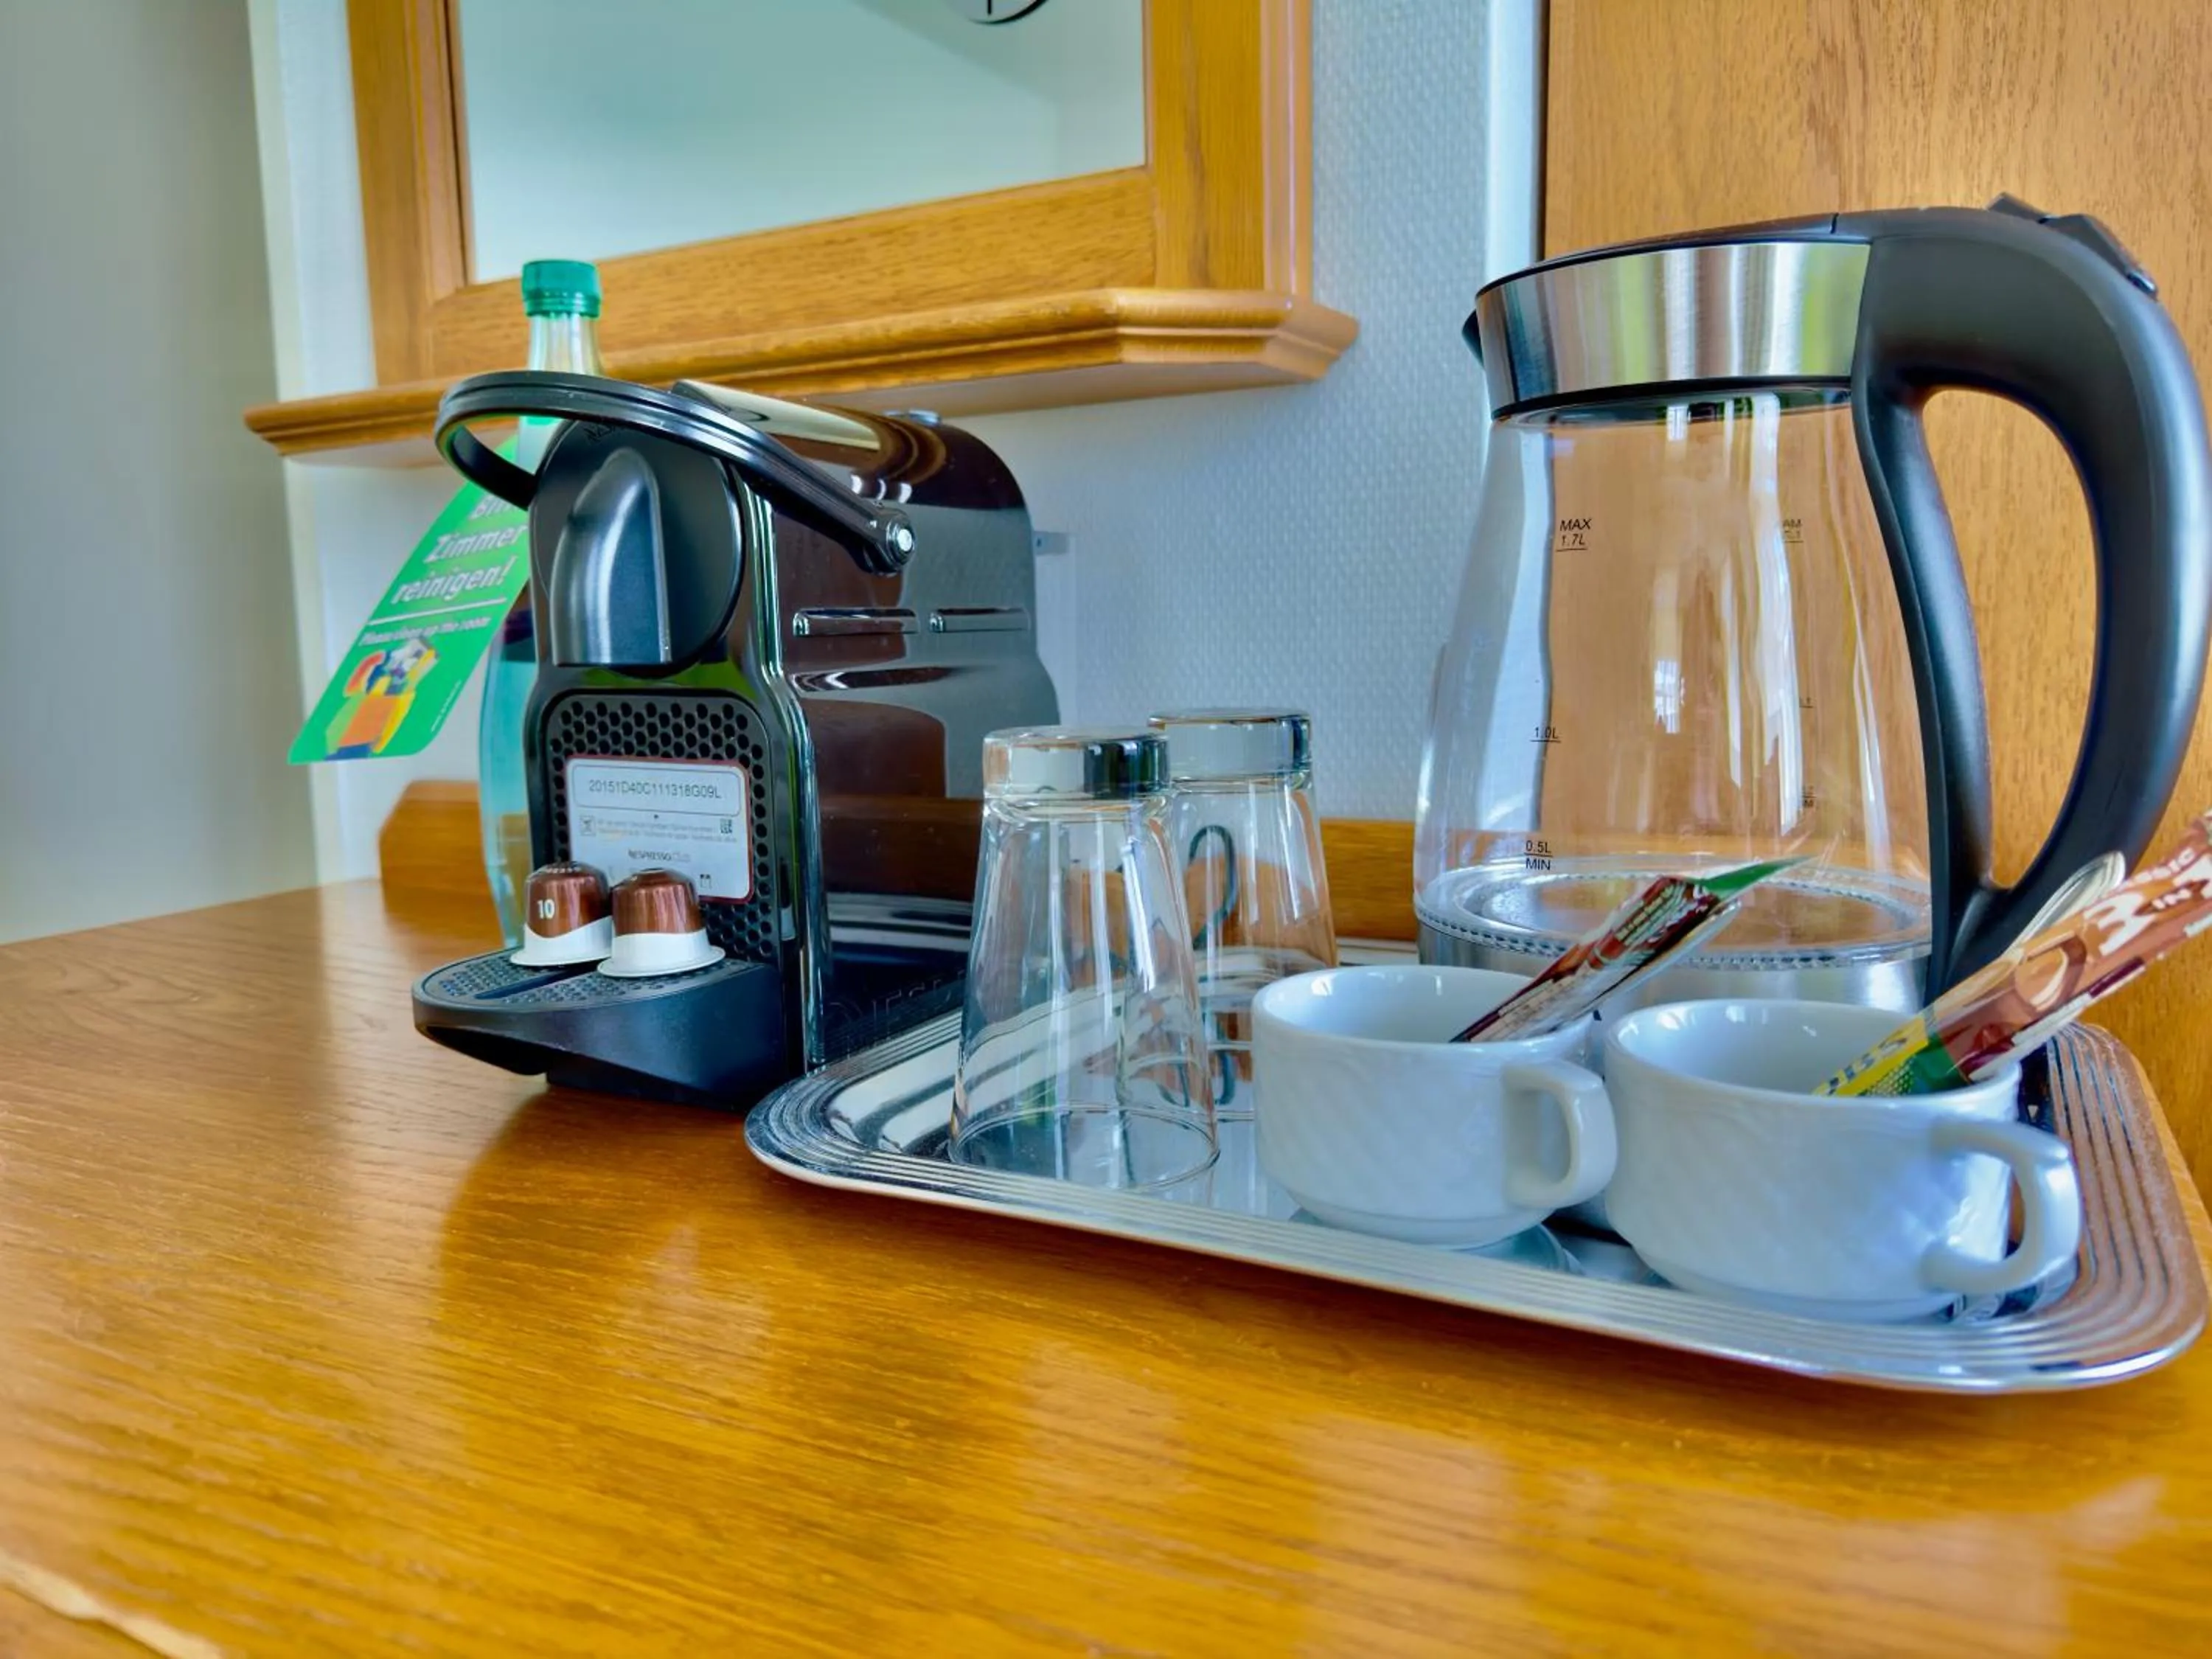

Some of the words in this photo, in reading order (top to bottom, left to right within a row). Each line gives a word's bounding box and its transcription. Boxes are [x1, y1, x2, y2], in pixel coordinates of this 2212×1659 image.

[1559, 518, 1592, 532] MAX
[422, 524, 529, 563] Zimmer
[1561, 533, 1585, 546] 1.7L
[390, 554, 518, 605] reinigen!
[1534, 726, 1559, 740] 1.0L
[1526, 840, 1552, 853] 0.5L
[1526, 858, 1551, 871] MIN
[537, 899, 555, 919] 10
[2083, 892, 2157, 956] 3
